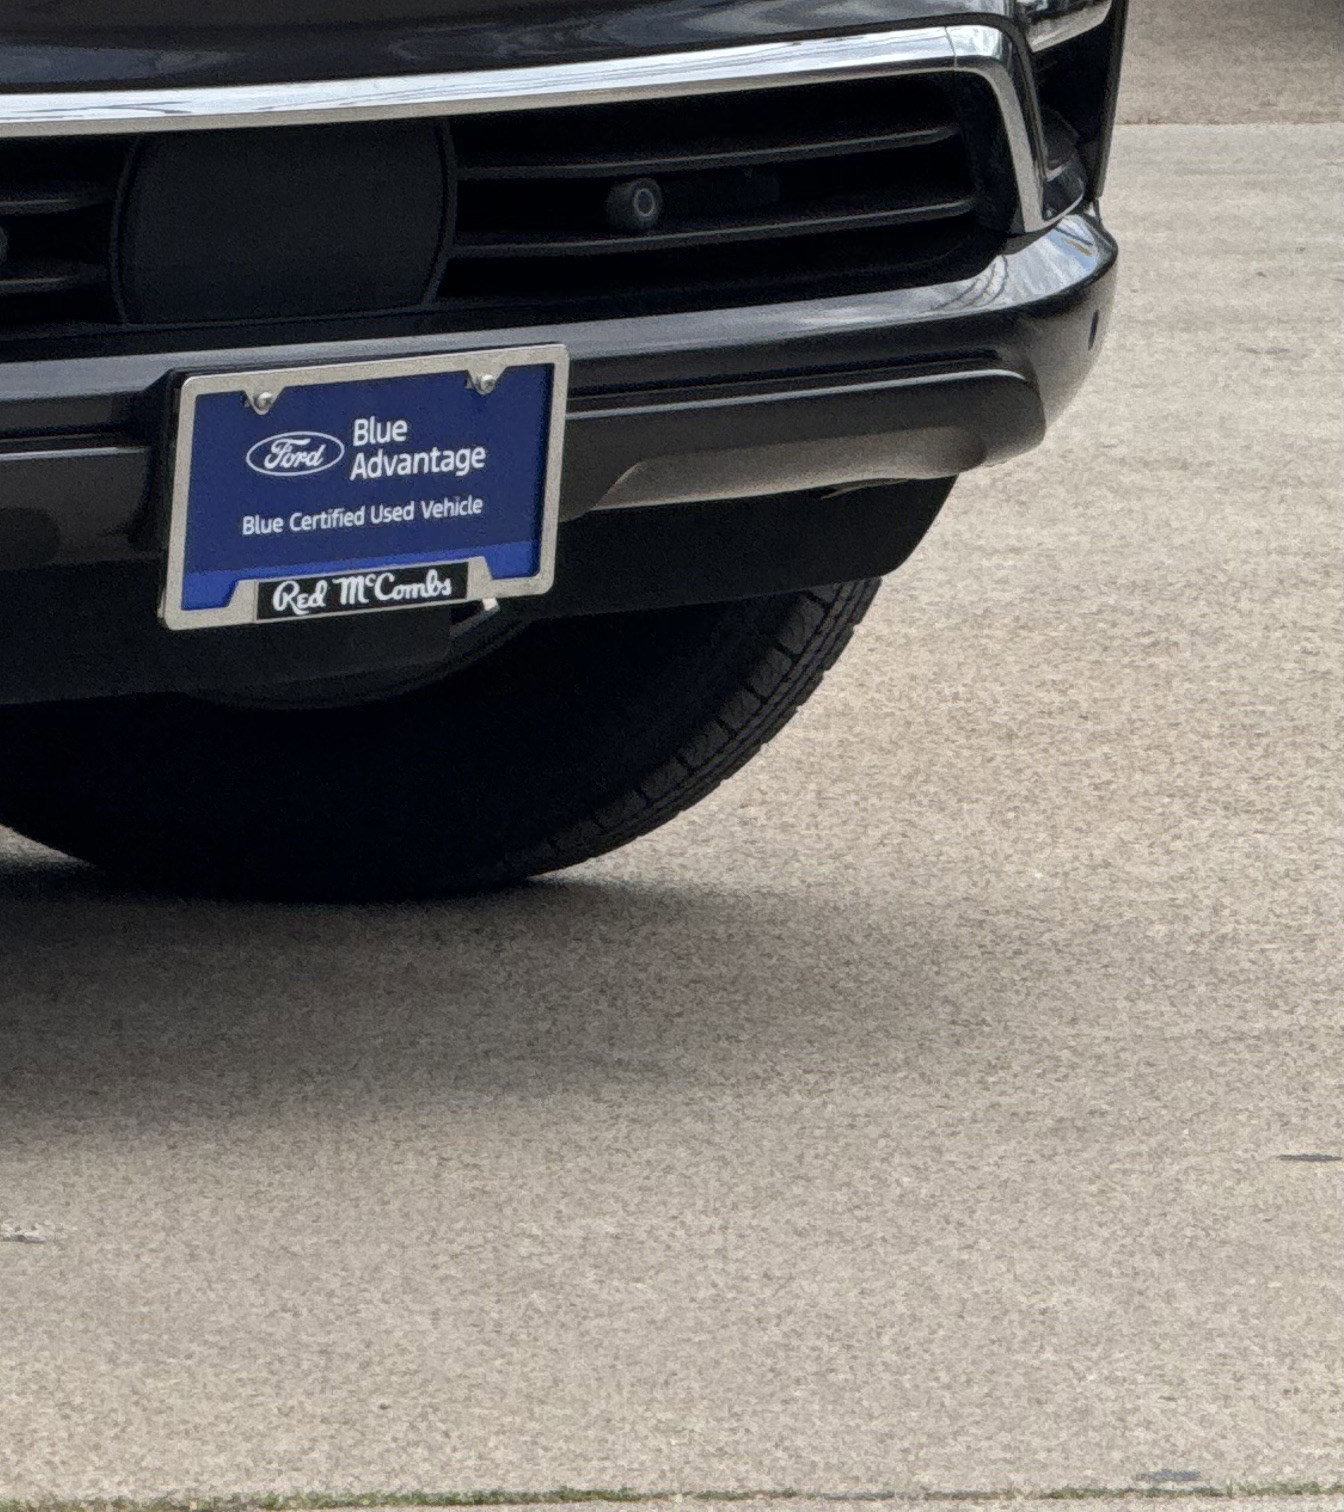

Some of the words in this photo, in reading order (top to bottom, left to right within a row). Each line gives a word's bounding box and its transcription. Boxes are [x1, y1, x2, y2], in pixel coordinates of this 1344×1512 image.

[352, 416, 408, 447] Blue
[264, 438, 326, 469] Ford
[349, 446, 487, 481] Advantage
[241, 514, 284, 536] Blue
[289, 505, 365, 532] Certified
[370, 500, 415, 525] Used
[420, 494, 484, 520] Vehicle
[272, 579, 330, 616] Red
[332, 568, 452, 606] McCombs
